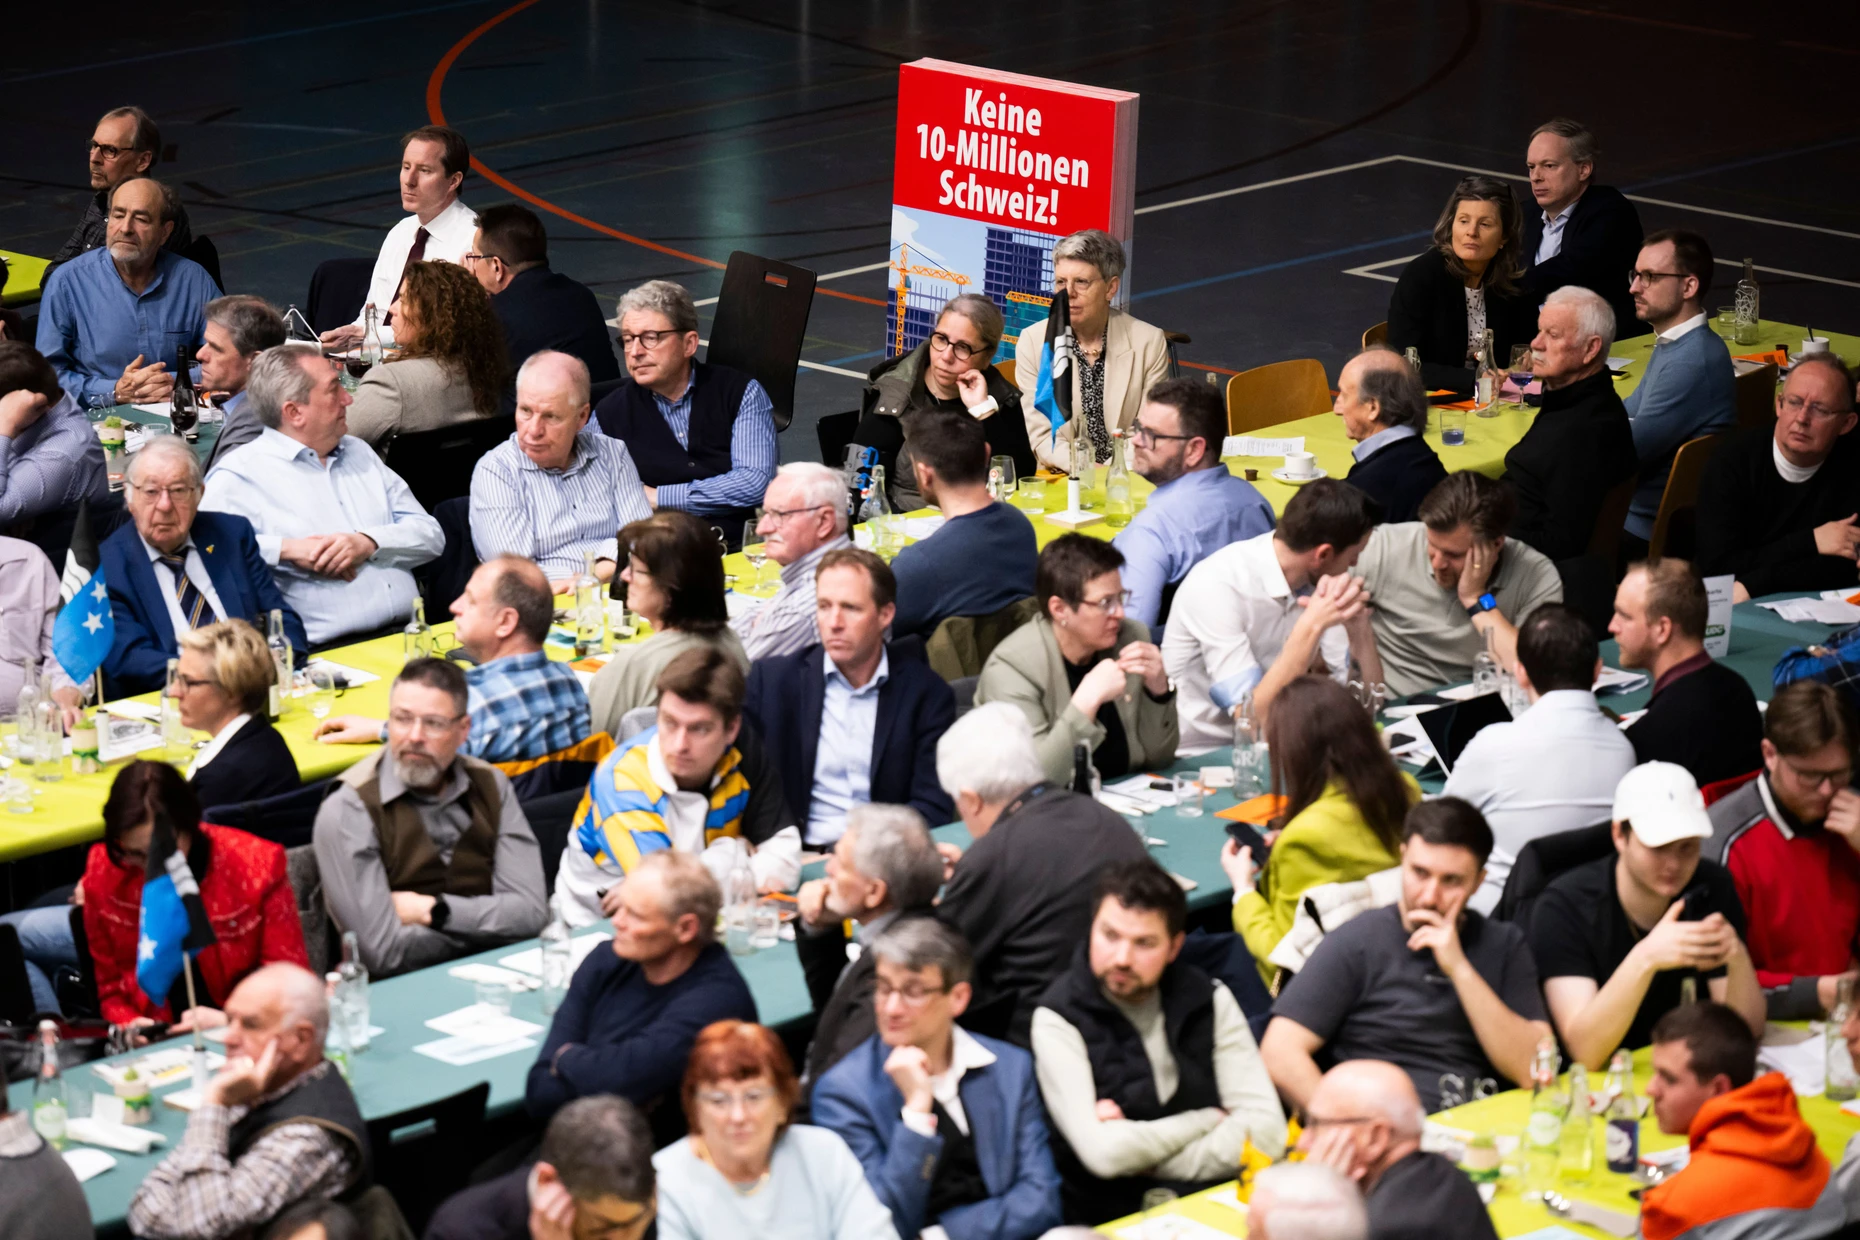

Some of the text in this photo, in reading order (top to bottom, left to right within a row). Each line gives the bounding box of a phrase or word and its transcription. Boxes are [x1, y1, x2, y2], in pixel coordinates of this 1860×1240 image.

[964, 87, 1042, 137] Keine
[916, 123, 1089, 188] 10-Millionen
[938, 169, 1059, 226] Schweiz!
